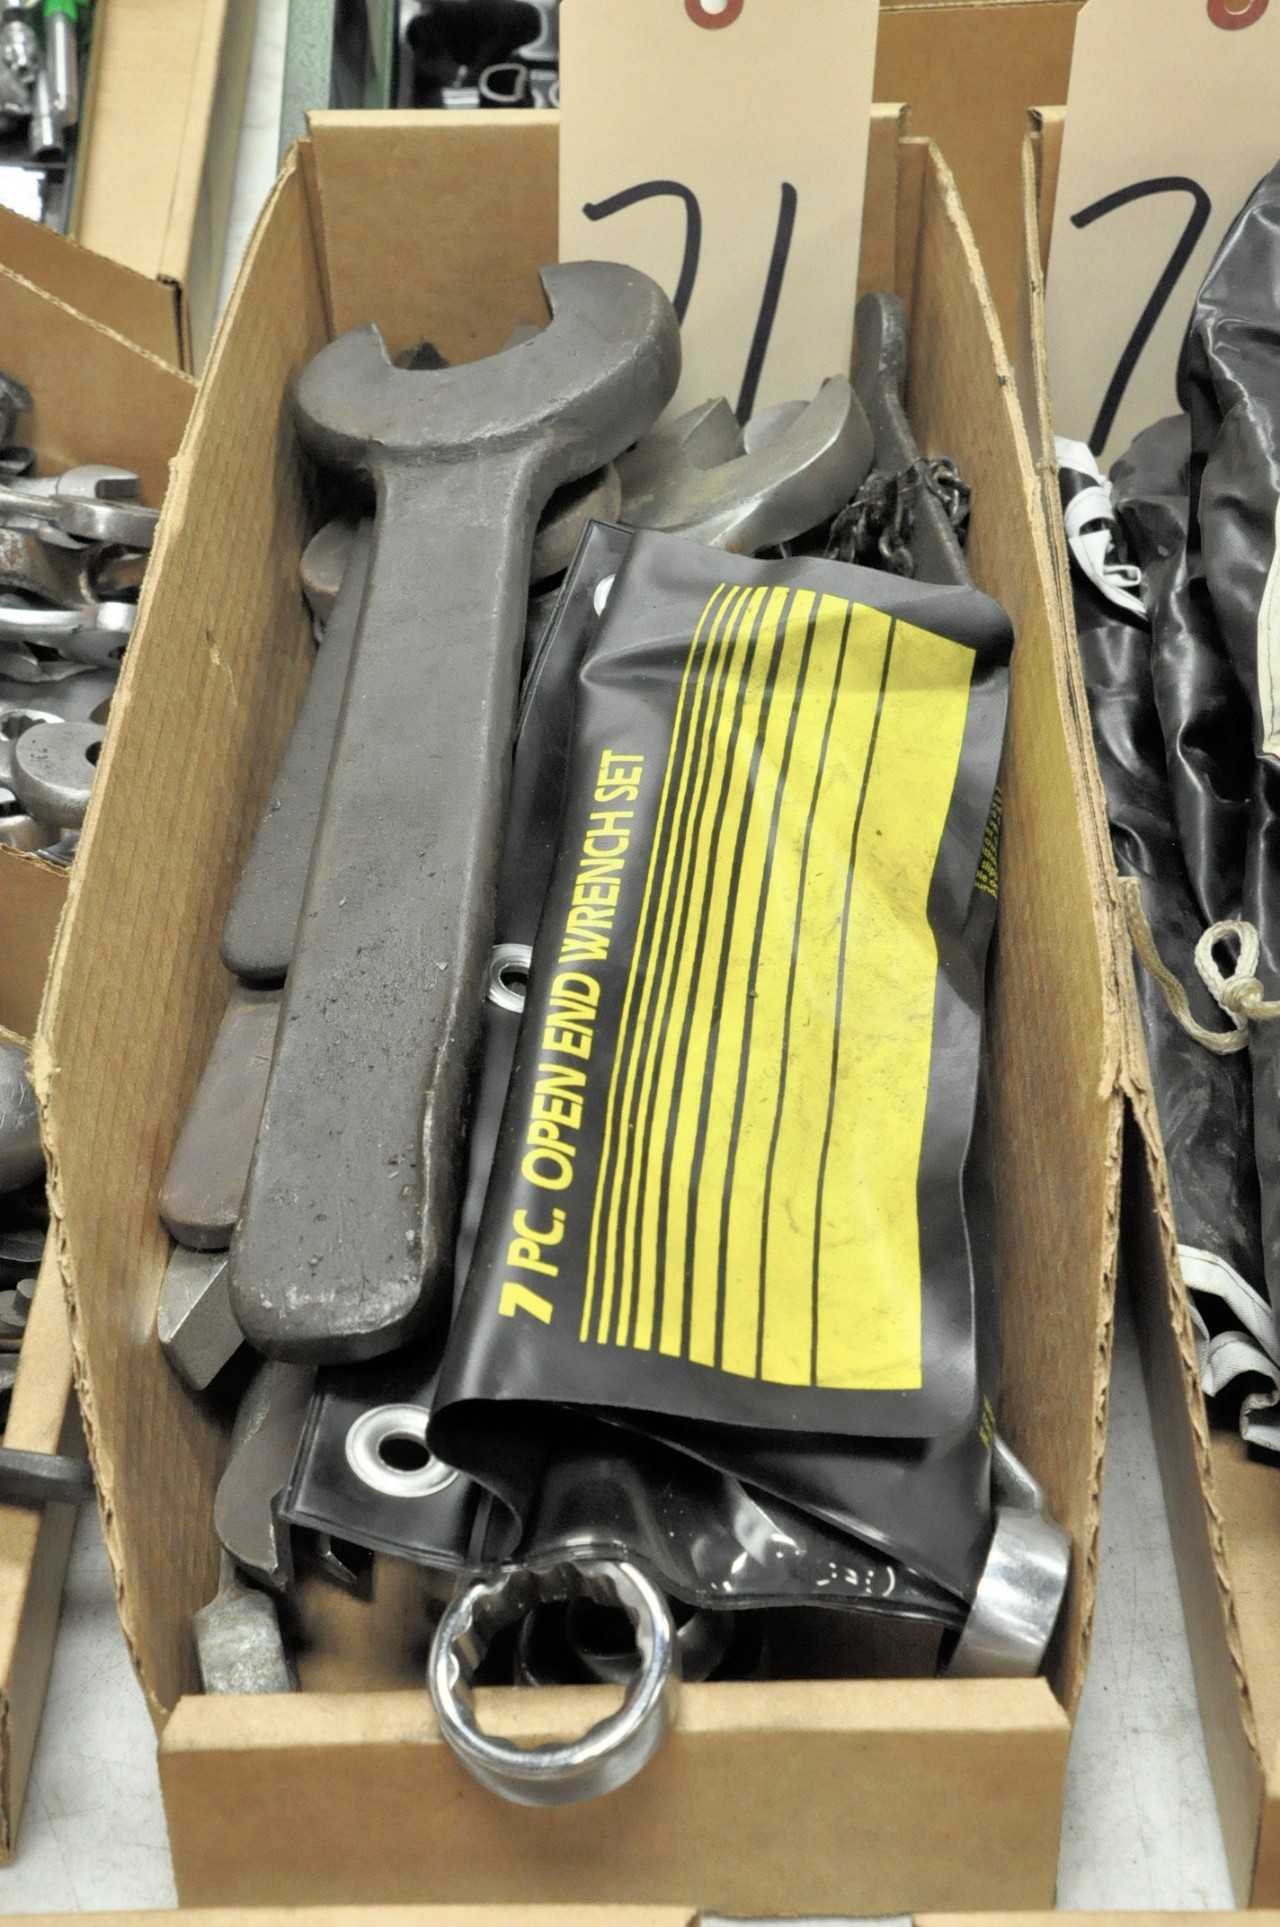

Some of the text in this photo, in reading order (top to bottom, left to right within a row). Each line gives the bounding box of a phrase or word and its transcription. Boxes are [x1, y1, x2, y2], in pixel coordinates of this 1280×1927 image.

[499, 748, 645, 1325] 7 PC. OPEN END WRENCH SET
